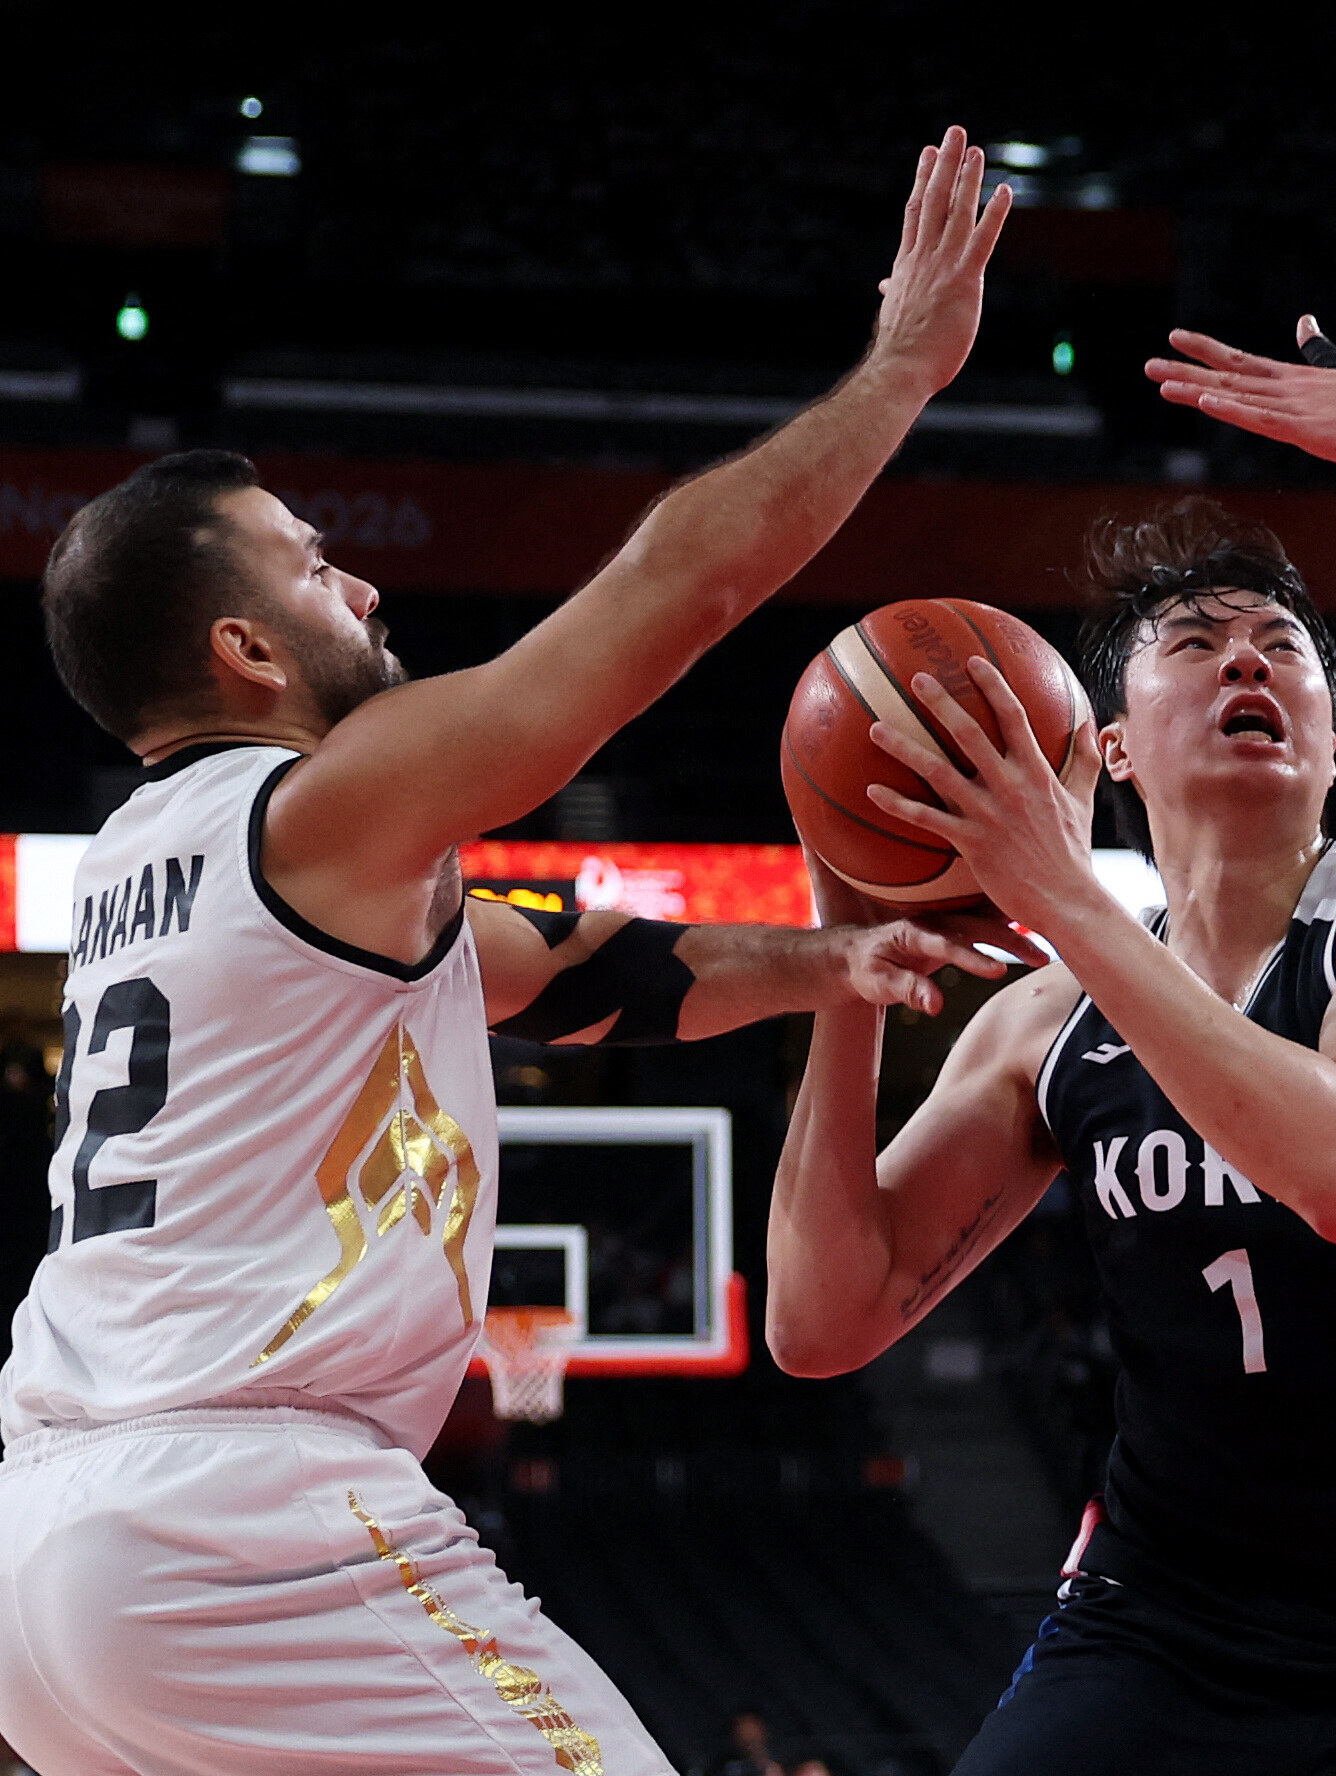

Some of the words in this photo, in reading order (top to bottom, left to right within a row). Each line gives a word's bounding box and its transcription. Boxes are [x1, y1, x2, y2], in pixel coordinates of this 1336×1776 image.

[73, 855, 205, 968] ANAAN
[1093, 1130, 1263, 1220] KOR
[1201, 1248, 1268, 1374] 1
